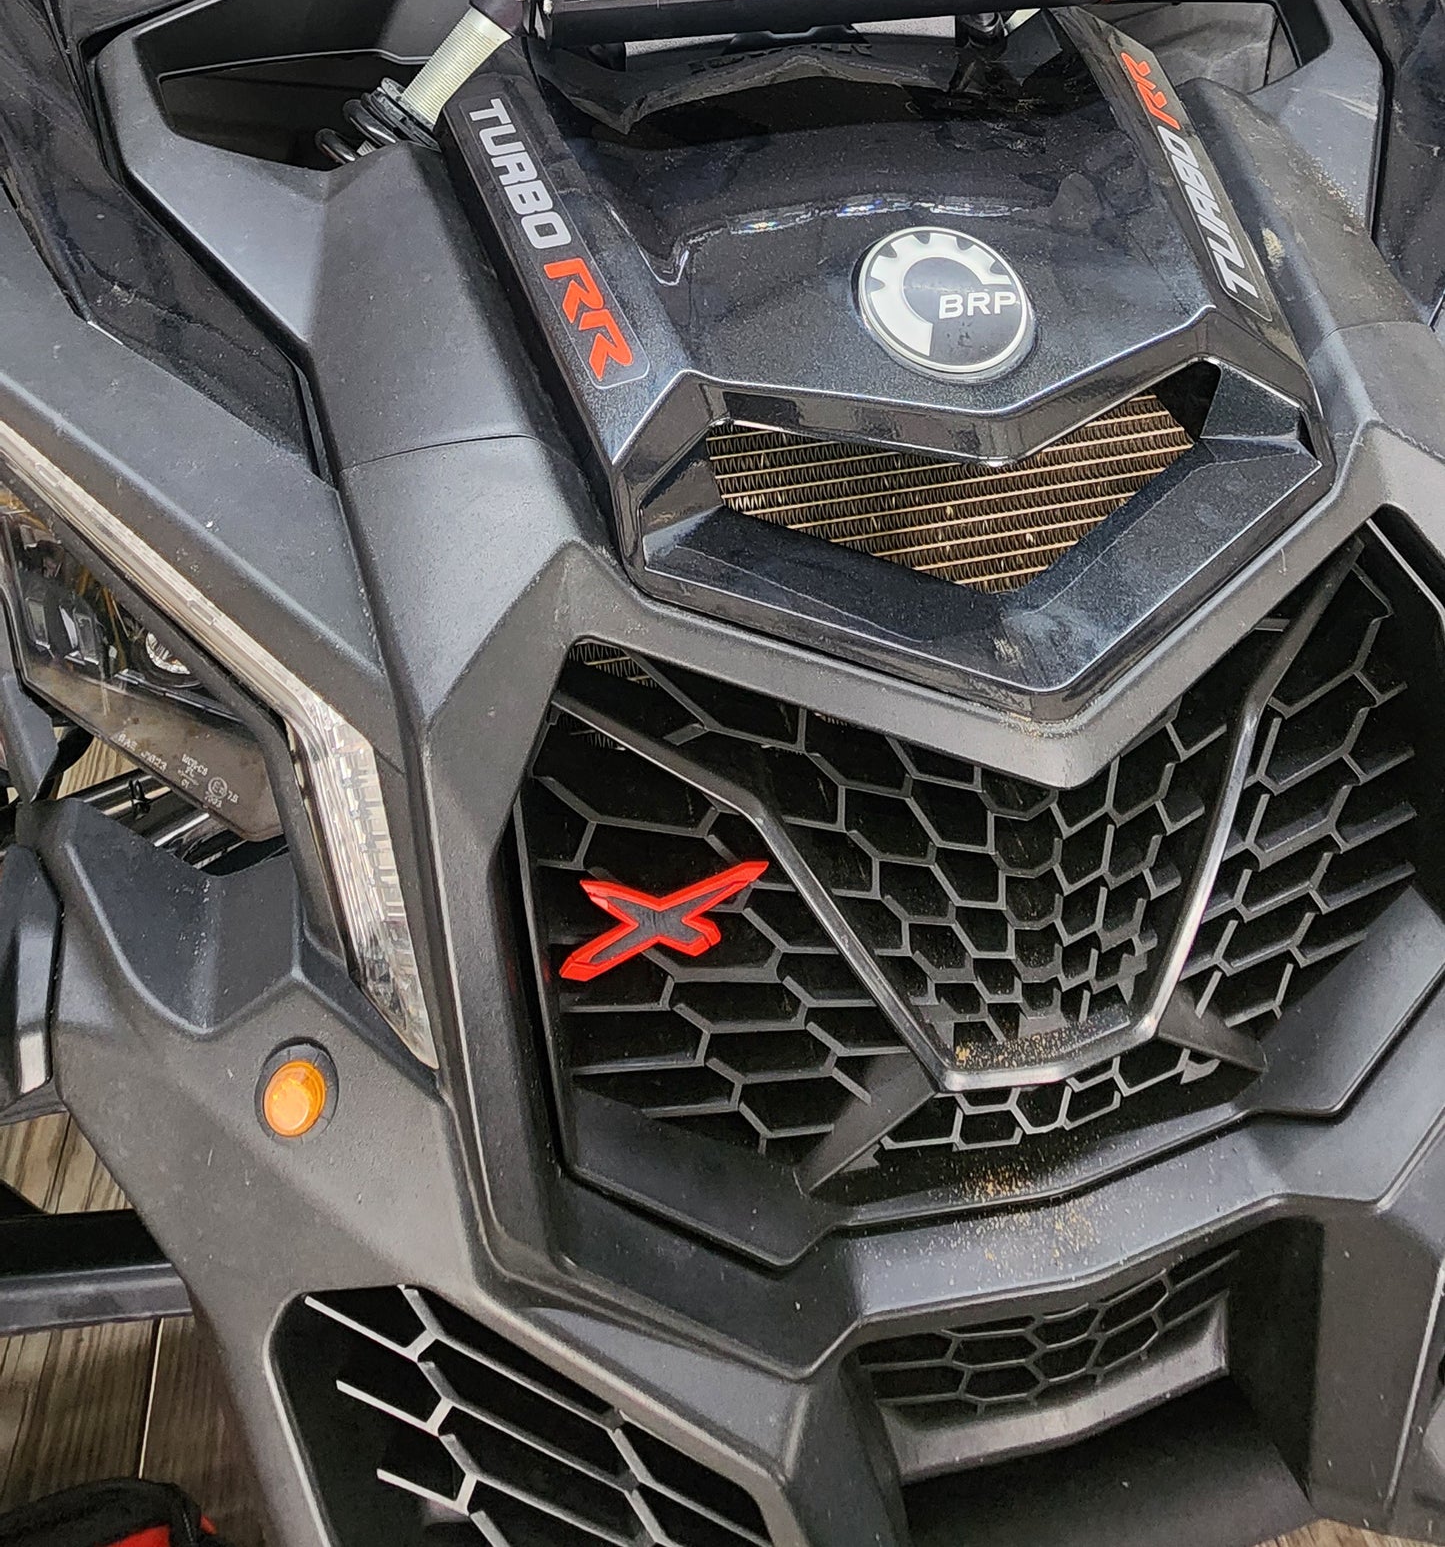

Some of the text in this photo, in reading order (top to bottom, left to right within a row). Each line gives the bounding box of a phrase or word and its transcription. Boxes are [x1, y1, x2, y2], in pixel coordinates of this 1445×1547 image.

[469, 98, 634, 382] TURBO RR
[1157, 125, 1260, 299] TURBO
[939, 291, 1017, 319] BRP
